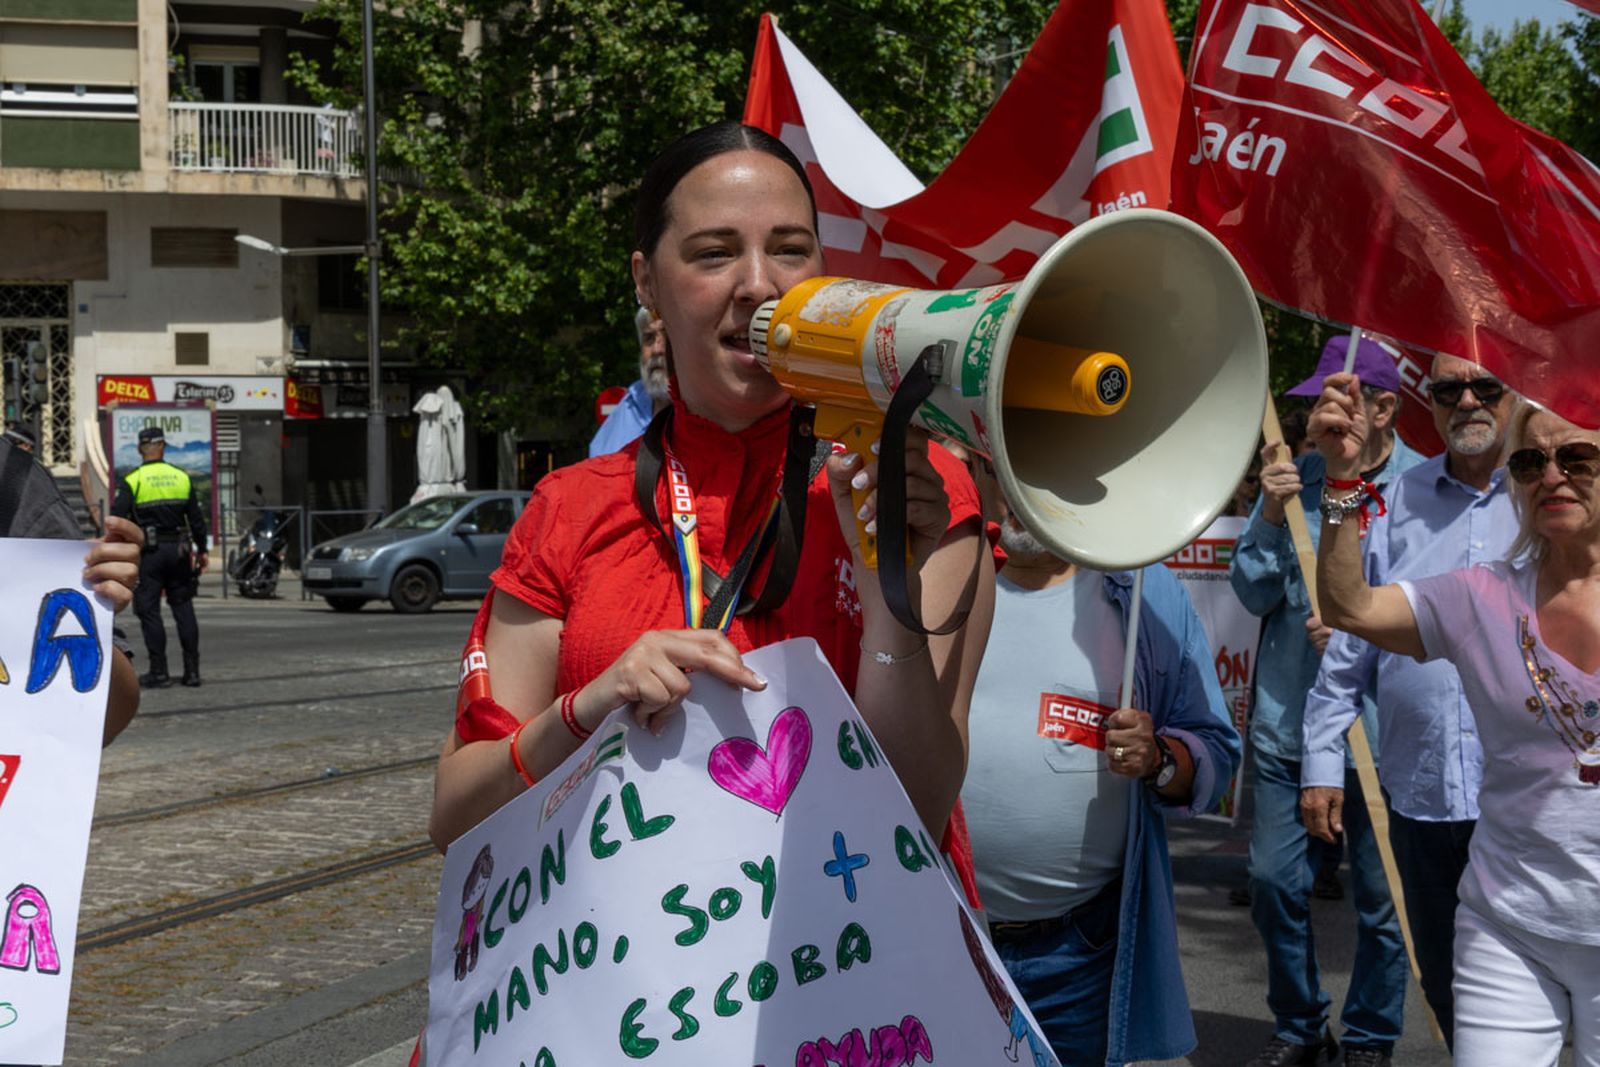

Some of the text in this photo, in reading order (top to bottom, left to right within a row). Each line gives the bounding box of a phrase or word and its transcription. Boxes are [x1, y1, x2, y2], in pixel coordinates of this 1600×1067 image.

[105, 380, 150, 399] DELTA
[483, 781, 676, 948] CON EL
[661, 855, 776, 947] SOY
[619, 922, 872, 1059] ESCOBA
